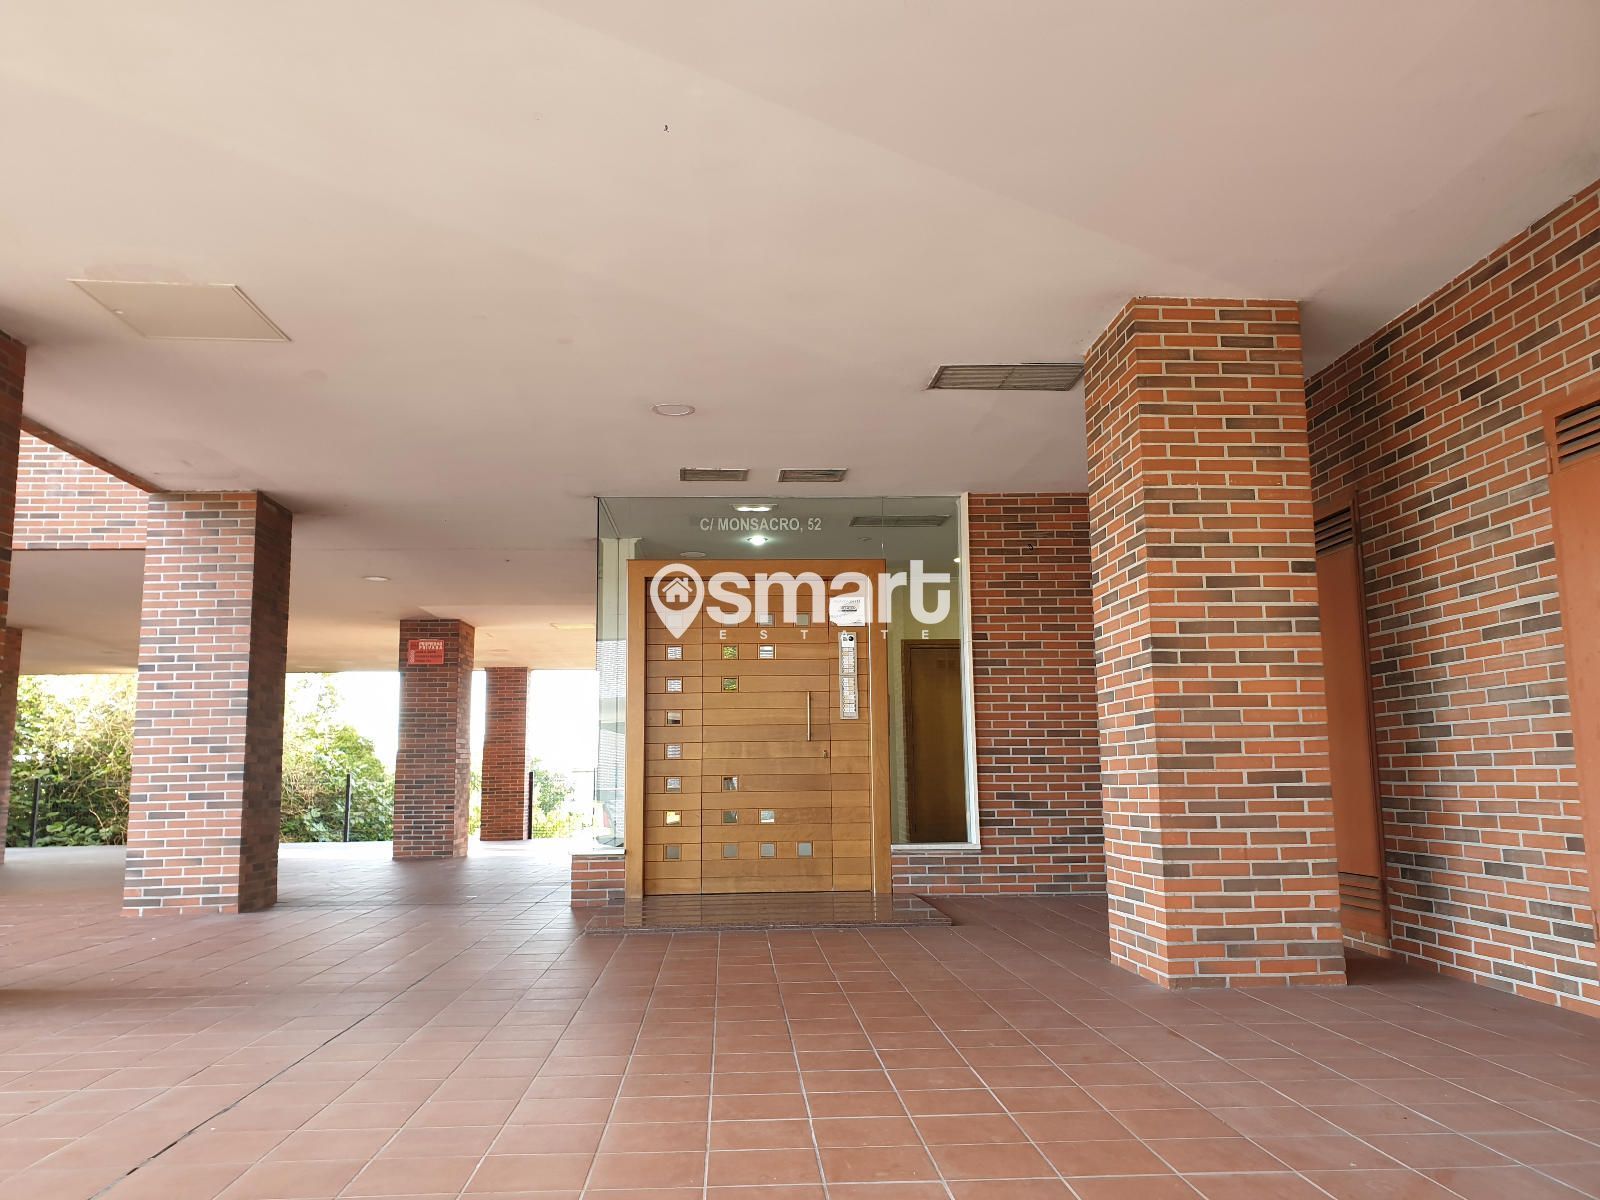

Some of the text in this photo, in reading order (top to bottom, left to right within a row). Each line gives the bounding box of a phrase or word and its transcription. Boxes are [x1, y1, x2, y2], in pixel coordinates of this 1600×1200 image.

[699, 517, 822, 533] C/ MONSACRO, 52
